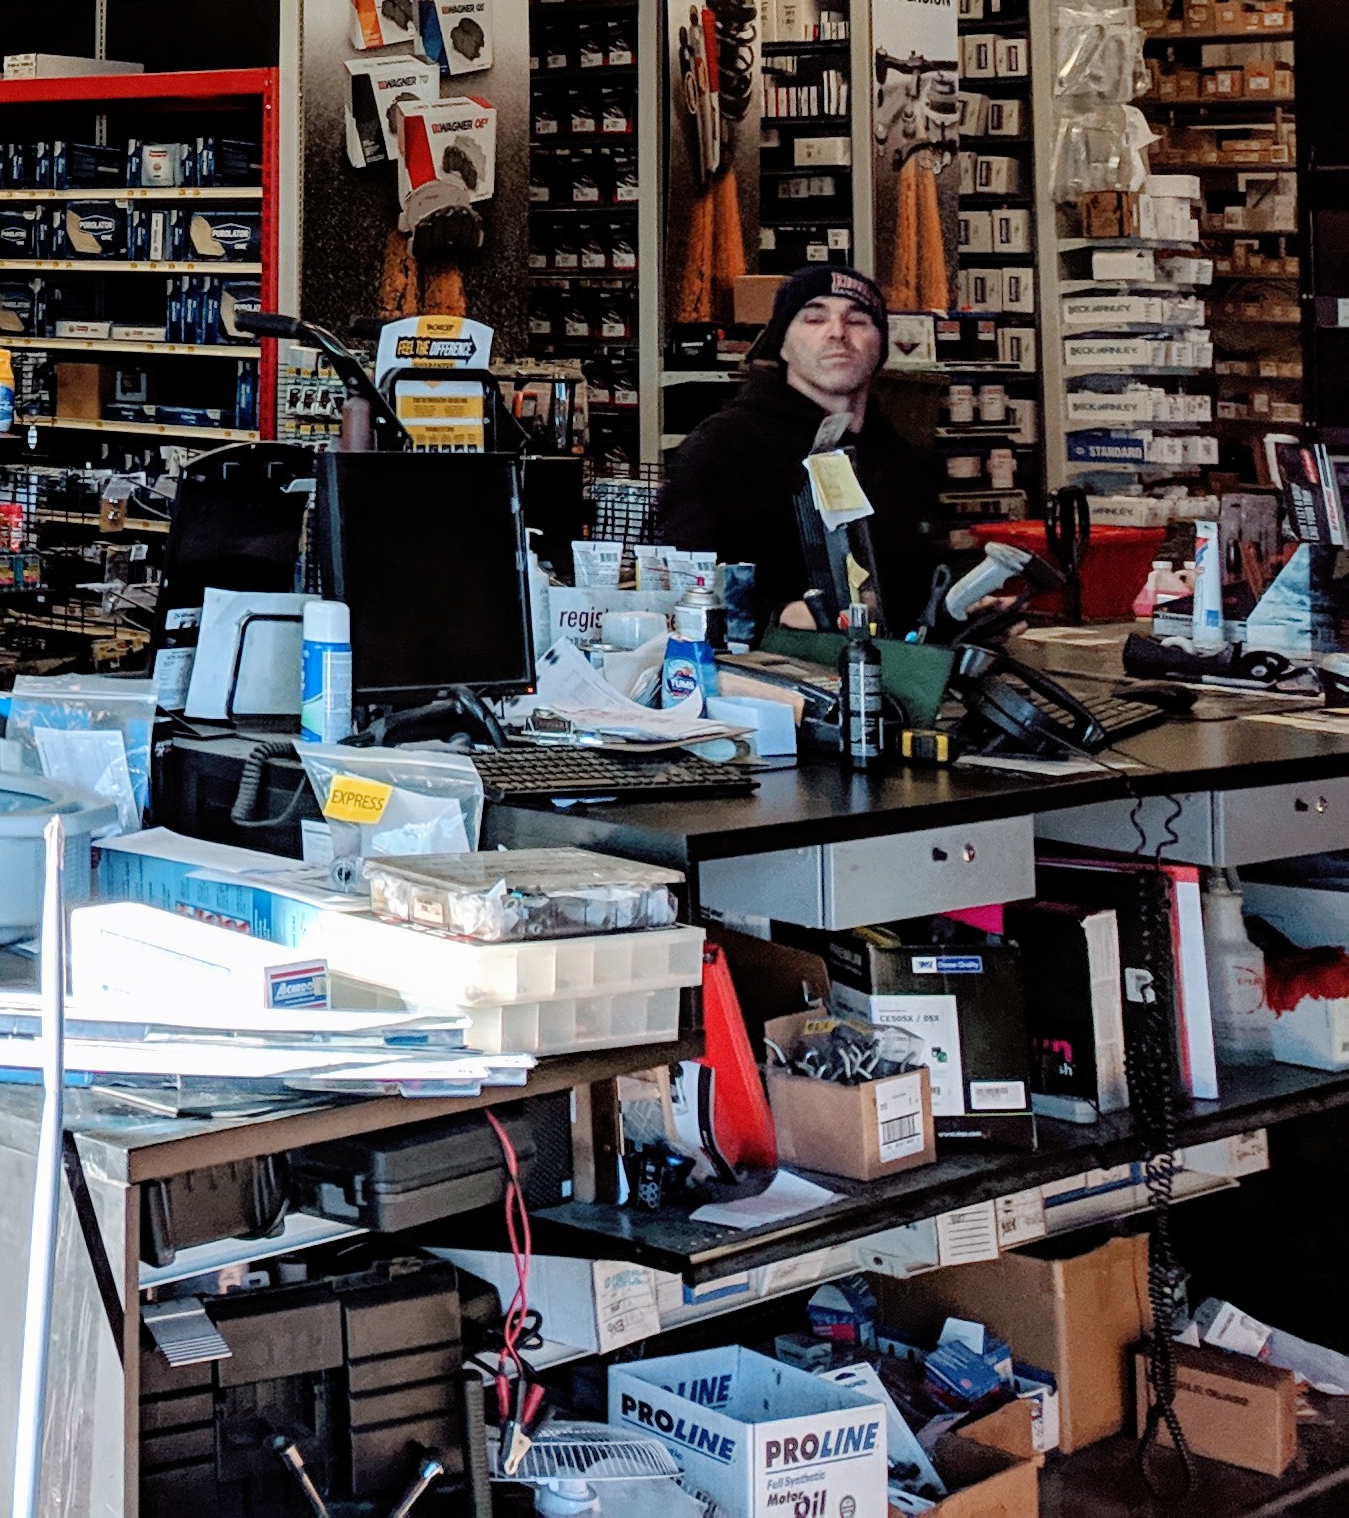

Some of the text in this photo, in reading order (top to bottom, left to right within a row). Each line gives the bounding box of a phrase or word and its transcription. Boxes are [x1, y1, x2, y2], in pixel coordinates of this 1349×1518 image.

[1089, 445, 1144, 459] STANDARD
[559, 606, 609, 633] regis
[671, 676, 695, 690] TUMS
[331, 789, 385, 812] EXPRESS
[659, 1373, 733, 1406] LINE
[621, 1393, 737, 1463] PROLINE
[765, 1420, 880, 1470] PROLINE
[767, 1471, 827, 1491] Full Synthetic
[767, 1489, 827, 1518] Motor Oil
